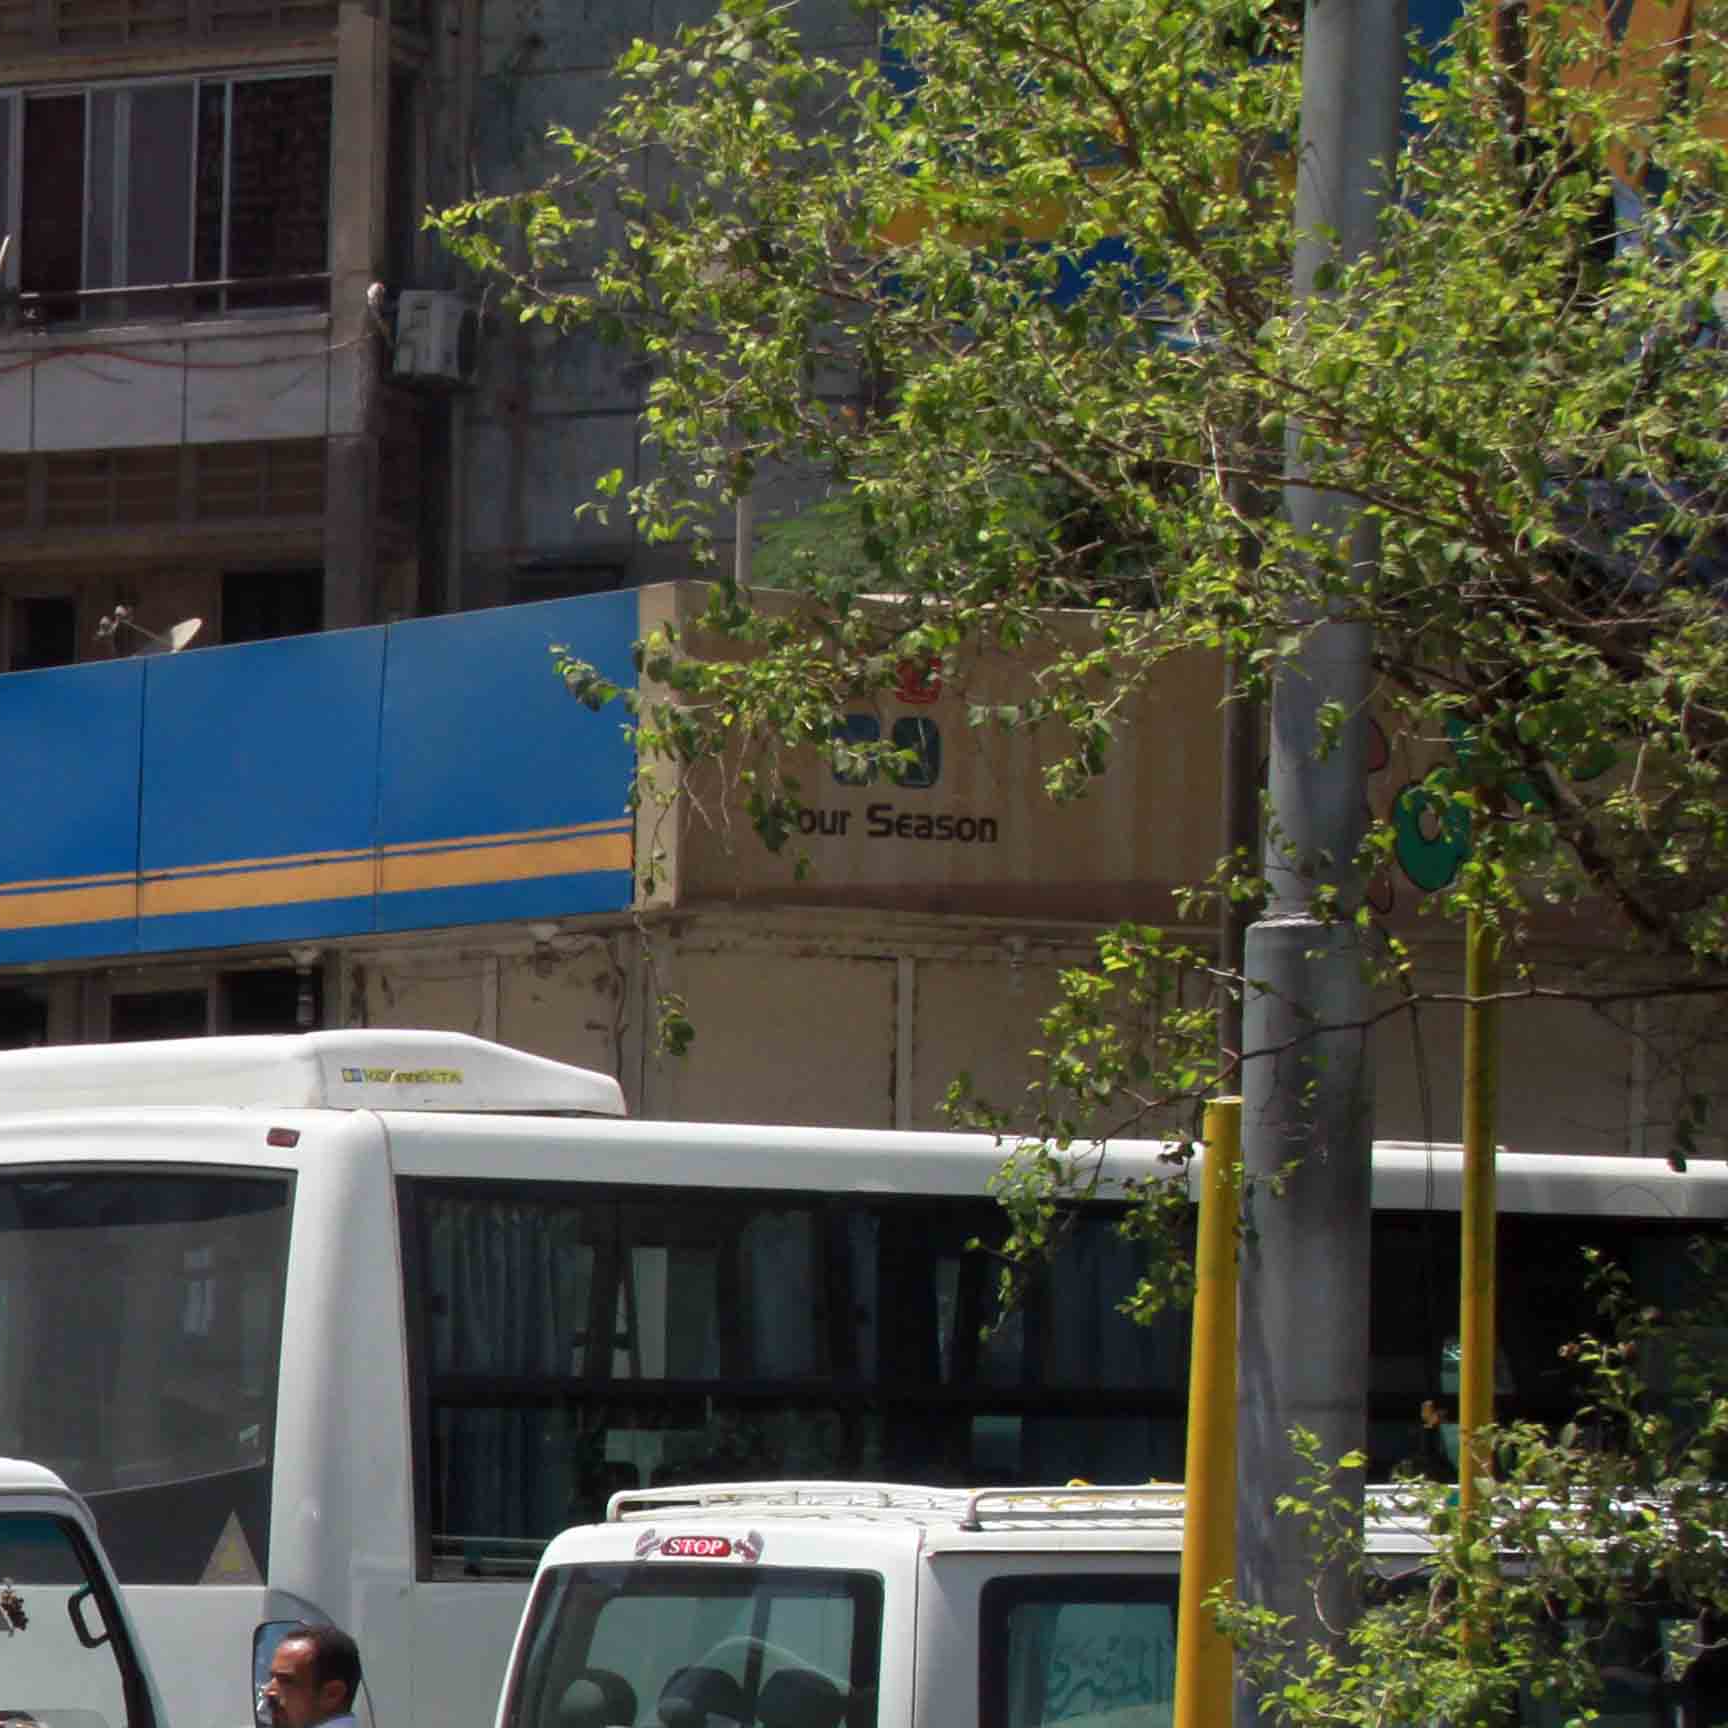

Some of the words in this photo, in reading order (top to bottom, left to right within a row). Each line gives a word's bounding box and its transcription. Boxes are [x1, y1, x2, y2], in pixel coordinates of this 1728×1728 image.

[776, 802, 852, 837] our
[866, 803, 999, 843] Season
[667, 1538, 724, 1556] STOP
